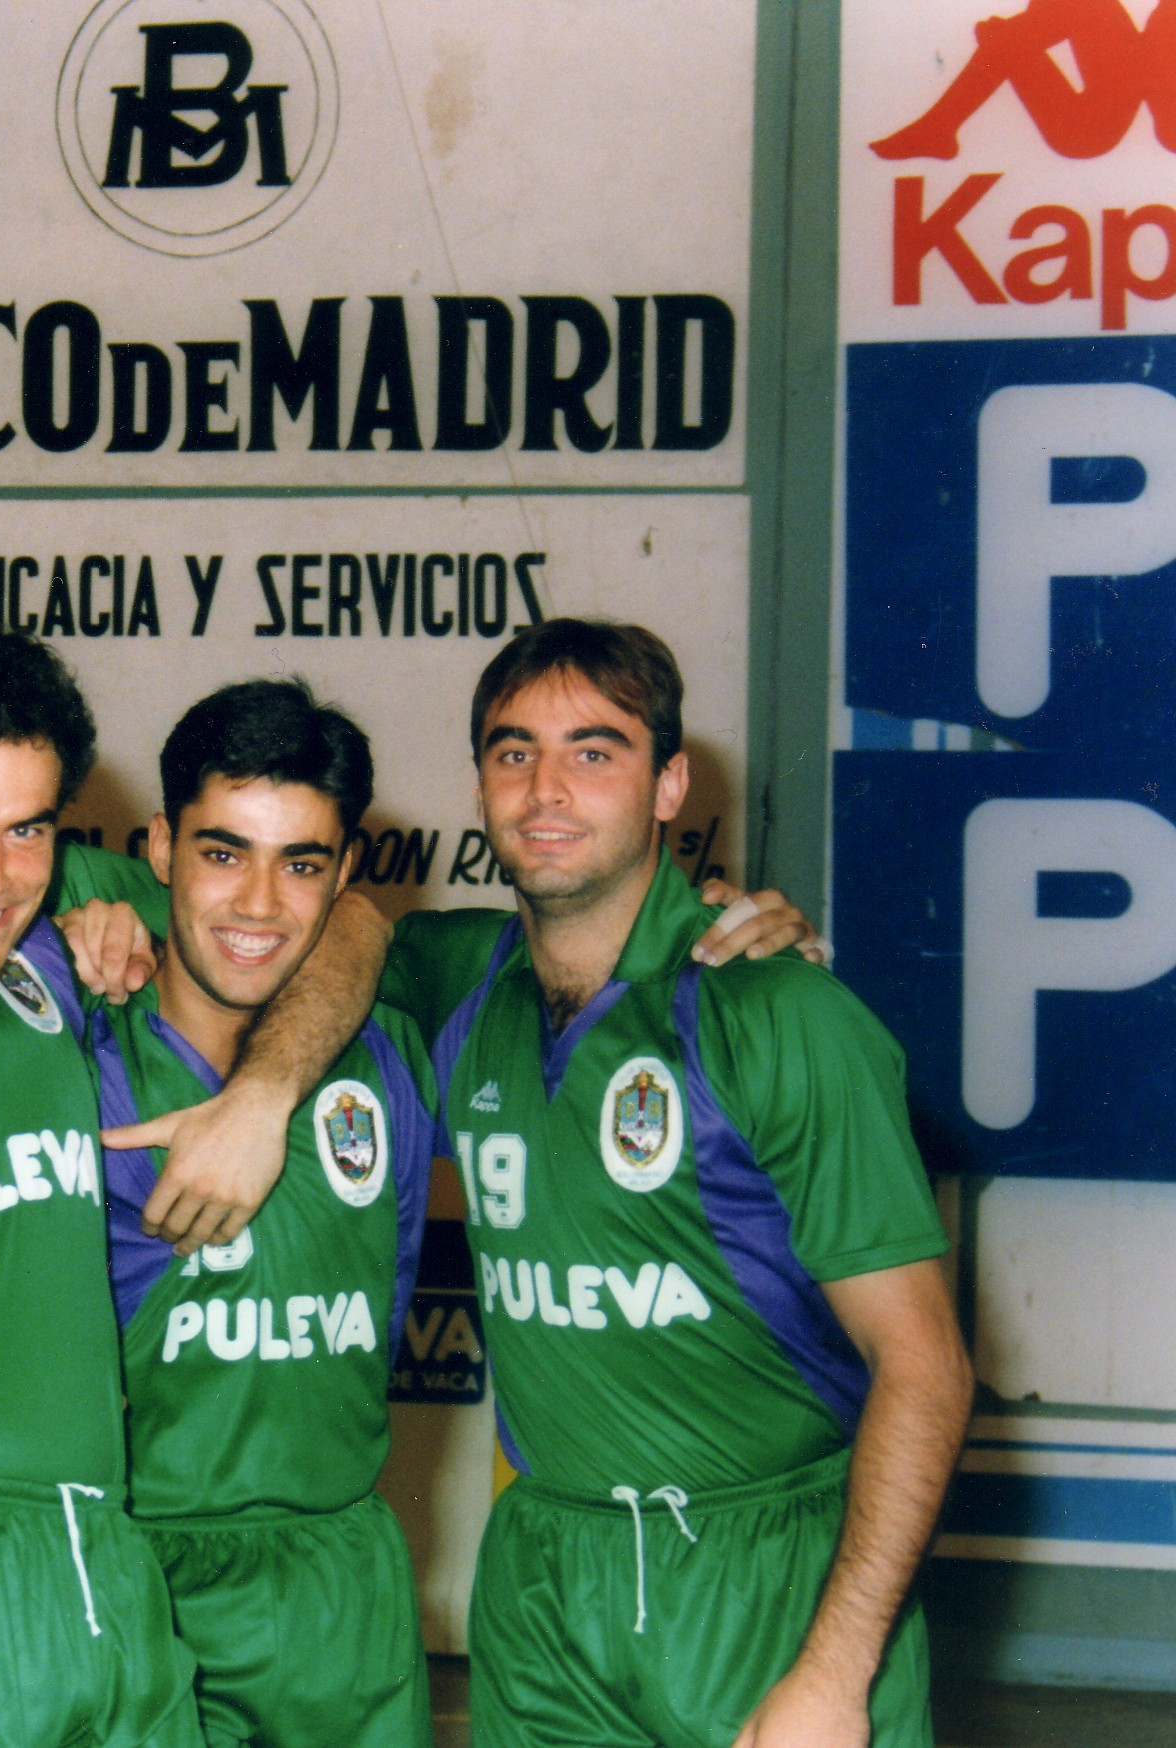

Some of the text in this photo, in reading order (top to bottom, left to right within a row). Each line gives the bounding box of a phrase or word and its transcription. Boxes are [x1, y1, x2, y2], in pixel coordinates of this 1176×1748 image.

[104, 340, 241, 455] DE
[241, 293, 737, 454] MADRID
[184, 553, 225, 638] Y
[254, 551, 548, 638] SERVICIOS
[456, 1131, 527, 1230] 19
[161, 1290, 377, 1364] PULEVA
[480, 1251, 712, 1330] PULEVA
